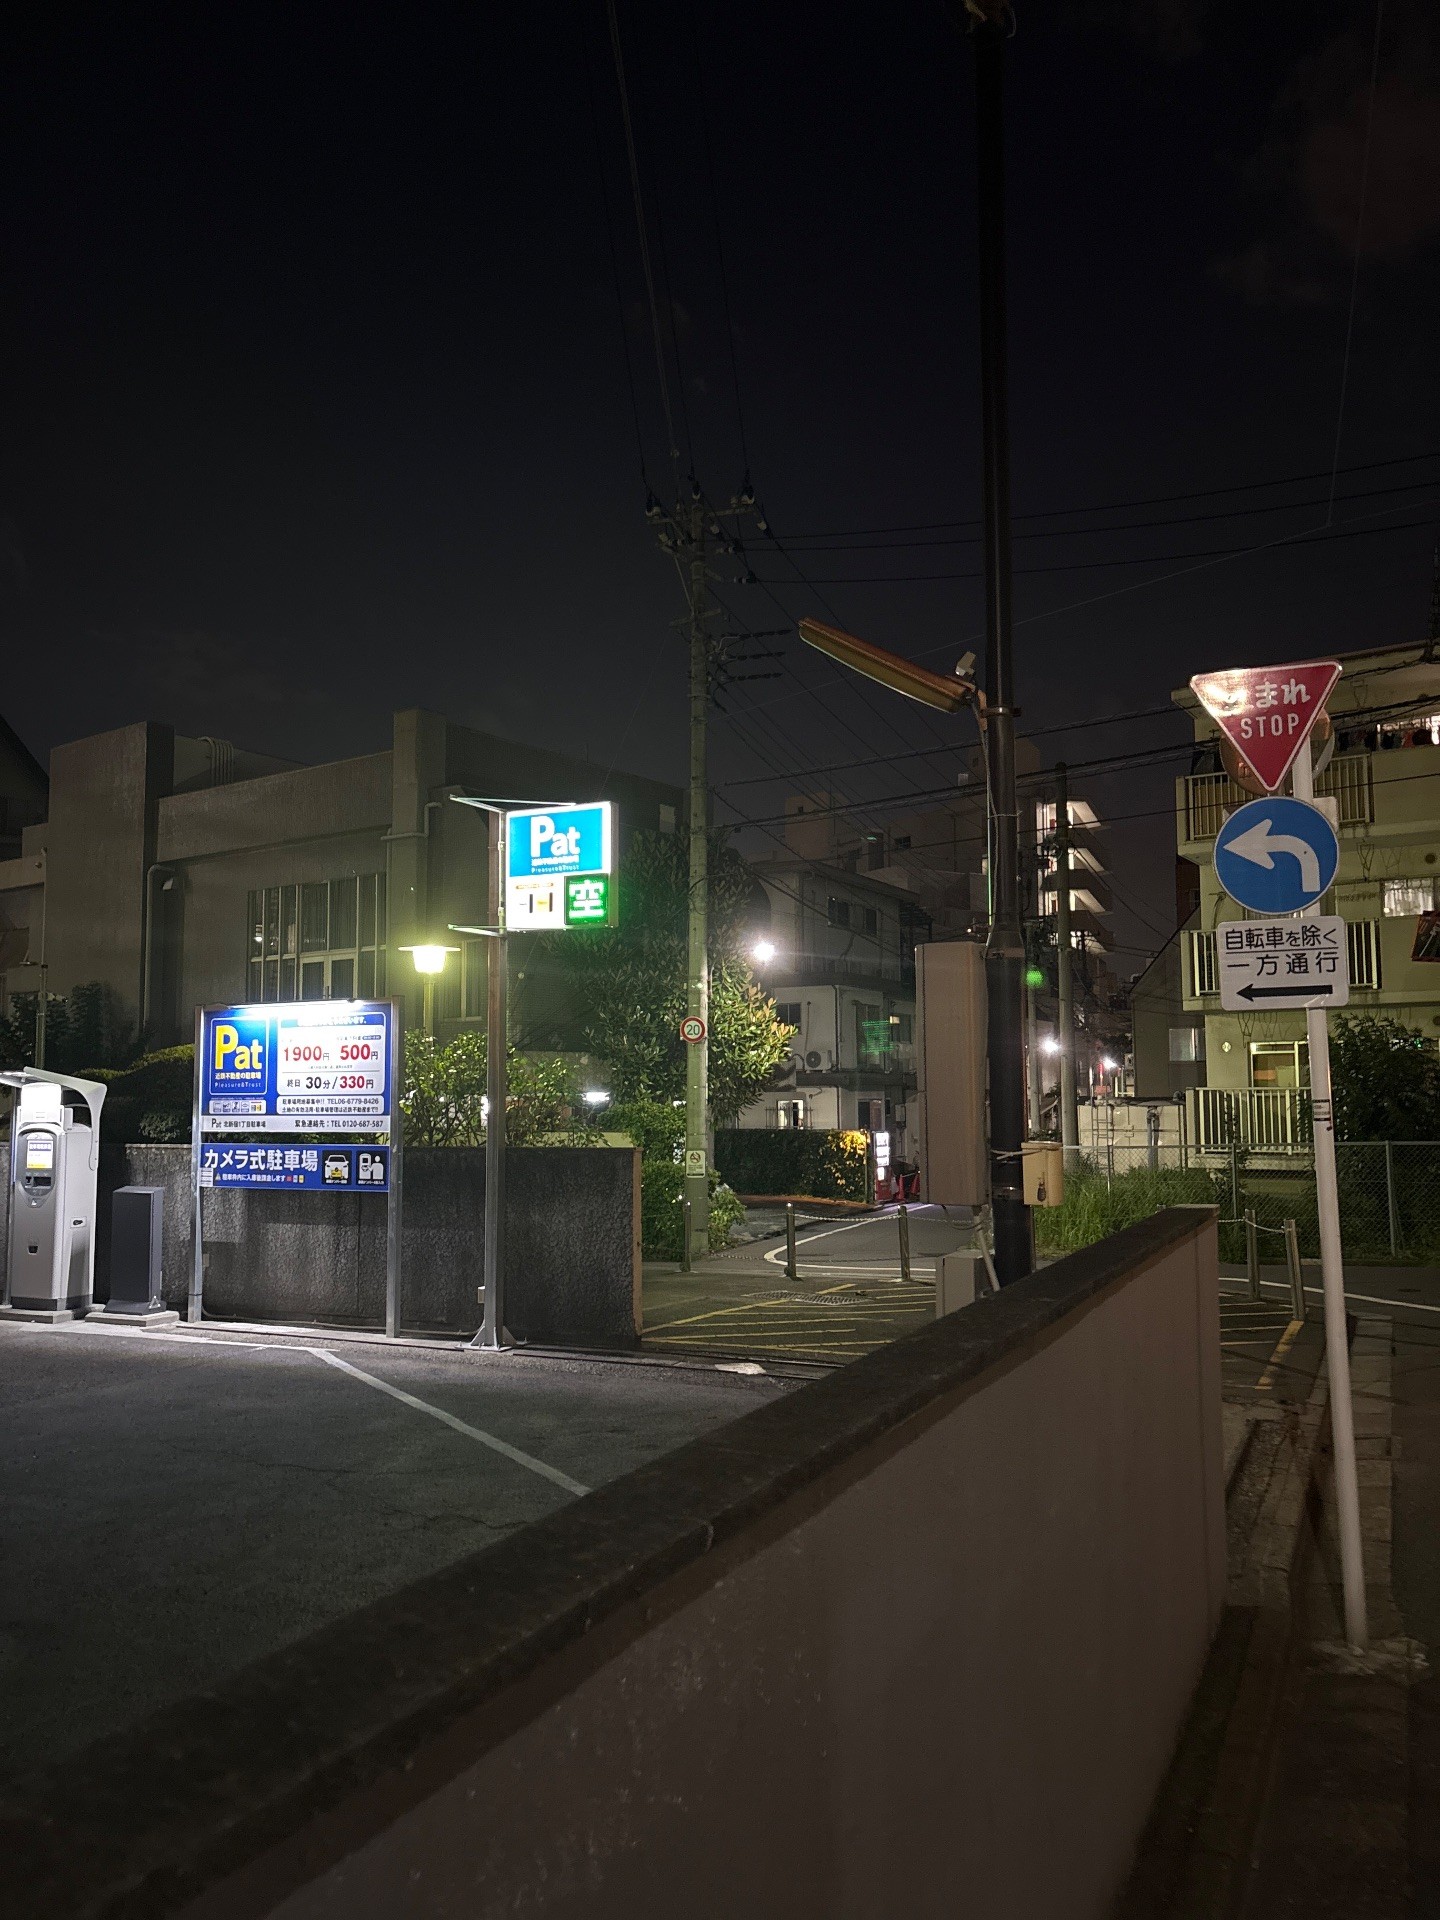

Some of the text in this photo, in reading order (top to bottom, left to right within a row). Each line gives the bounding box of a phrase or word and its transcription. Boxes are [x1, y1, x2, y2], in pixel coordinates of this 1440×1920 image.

[1224, 678, 1311, 713] まれ
[1240, 713, 1299, 739] STOP
[530, 815, 581, 857] Pat
[569, 880, 604, 919] 空
[1225, 925, 1337, 950] 自転車を除く
[1227, 952, 1340, 976] 一方通行
[686, 1024, 700, 1036] 20
[215, 1025, 263, 1070] Pat
[340, 1043, 379, 1061] 500円
[287, 1079, 301, 1088] 終日
[204, 1148, 319, 1172] カメラ式駐車場
